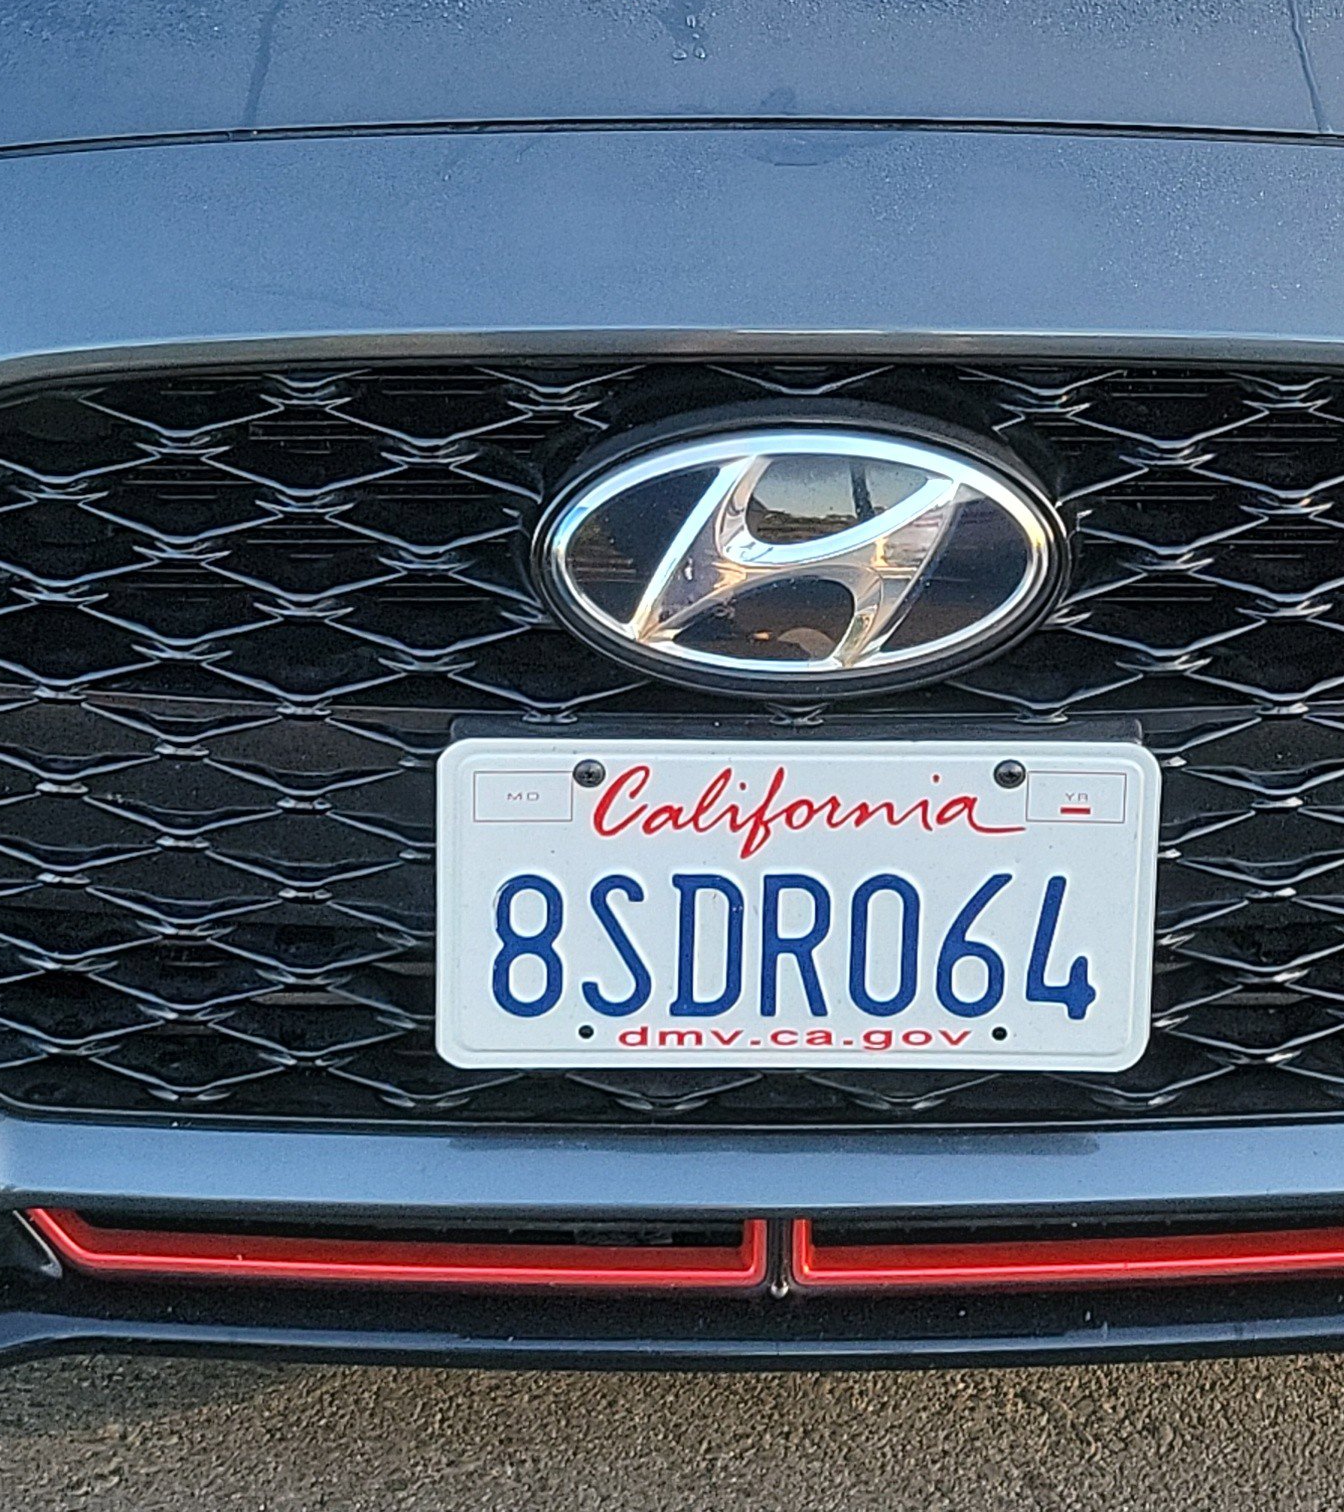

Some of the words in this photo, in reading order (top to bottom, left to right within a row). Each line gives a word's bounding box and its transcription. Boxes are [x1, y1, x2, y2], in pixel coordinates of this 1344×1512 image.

[507, 791, 540, 802] MO
[1065, 792, 1089, 802] YR
[593, 765, 1025, 859] California
[492, 873, 1096, 1020] 8SDR064
[618, 1026, 972, 1050] dmv.ca.gov
